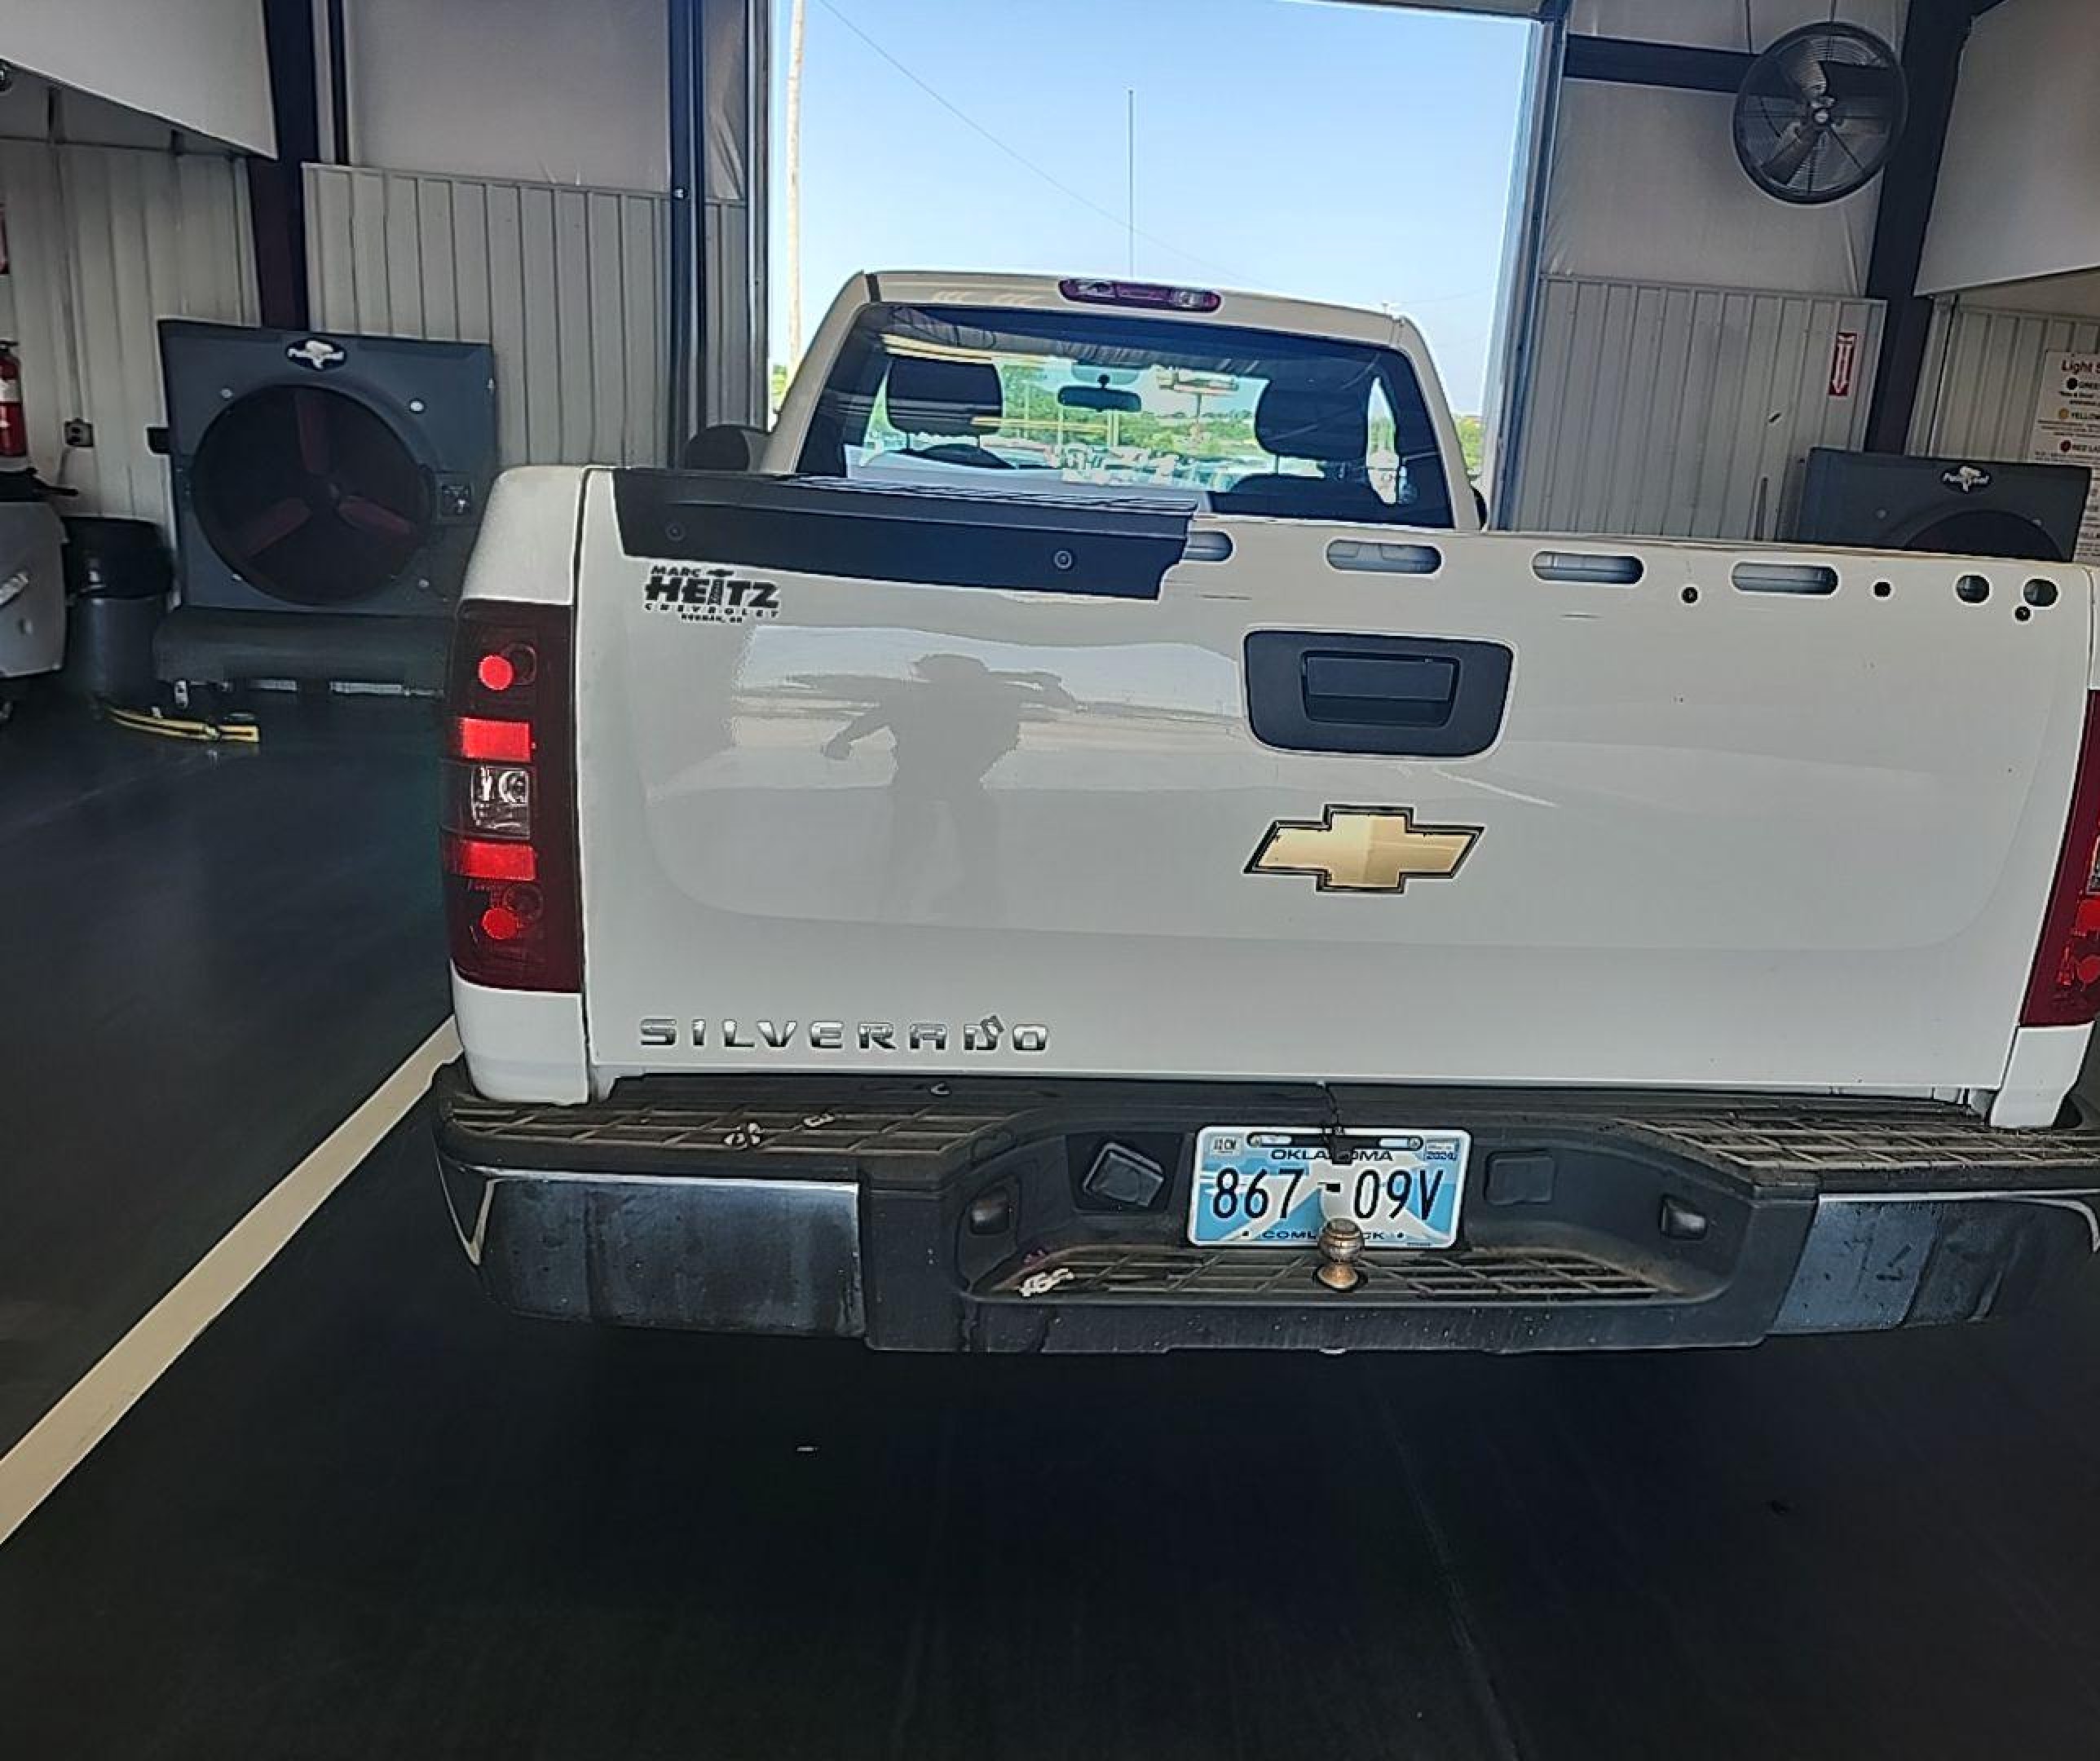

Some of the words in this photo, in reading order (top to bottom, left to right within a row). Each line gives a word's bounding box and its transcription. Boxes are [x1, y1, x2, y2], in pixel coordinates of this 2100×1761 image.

[2062, 360, 2093, 374] Light
[645, 576, 779, 609] HEITZ
[639, 1014, 1049, 1052] SILVERADO
[1271, 1149, 1393, 1162] OKLAOMA
